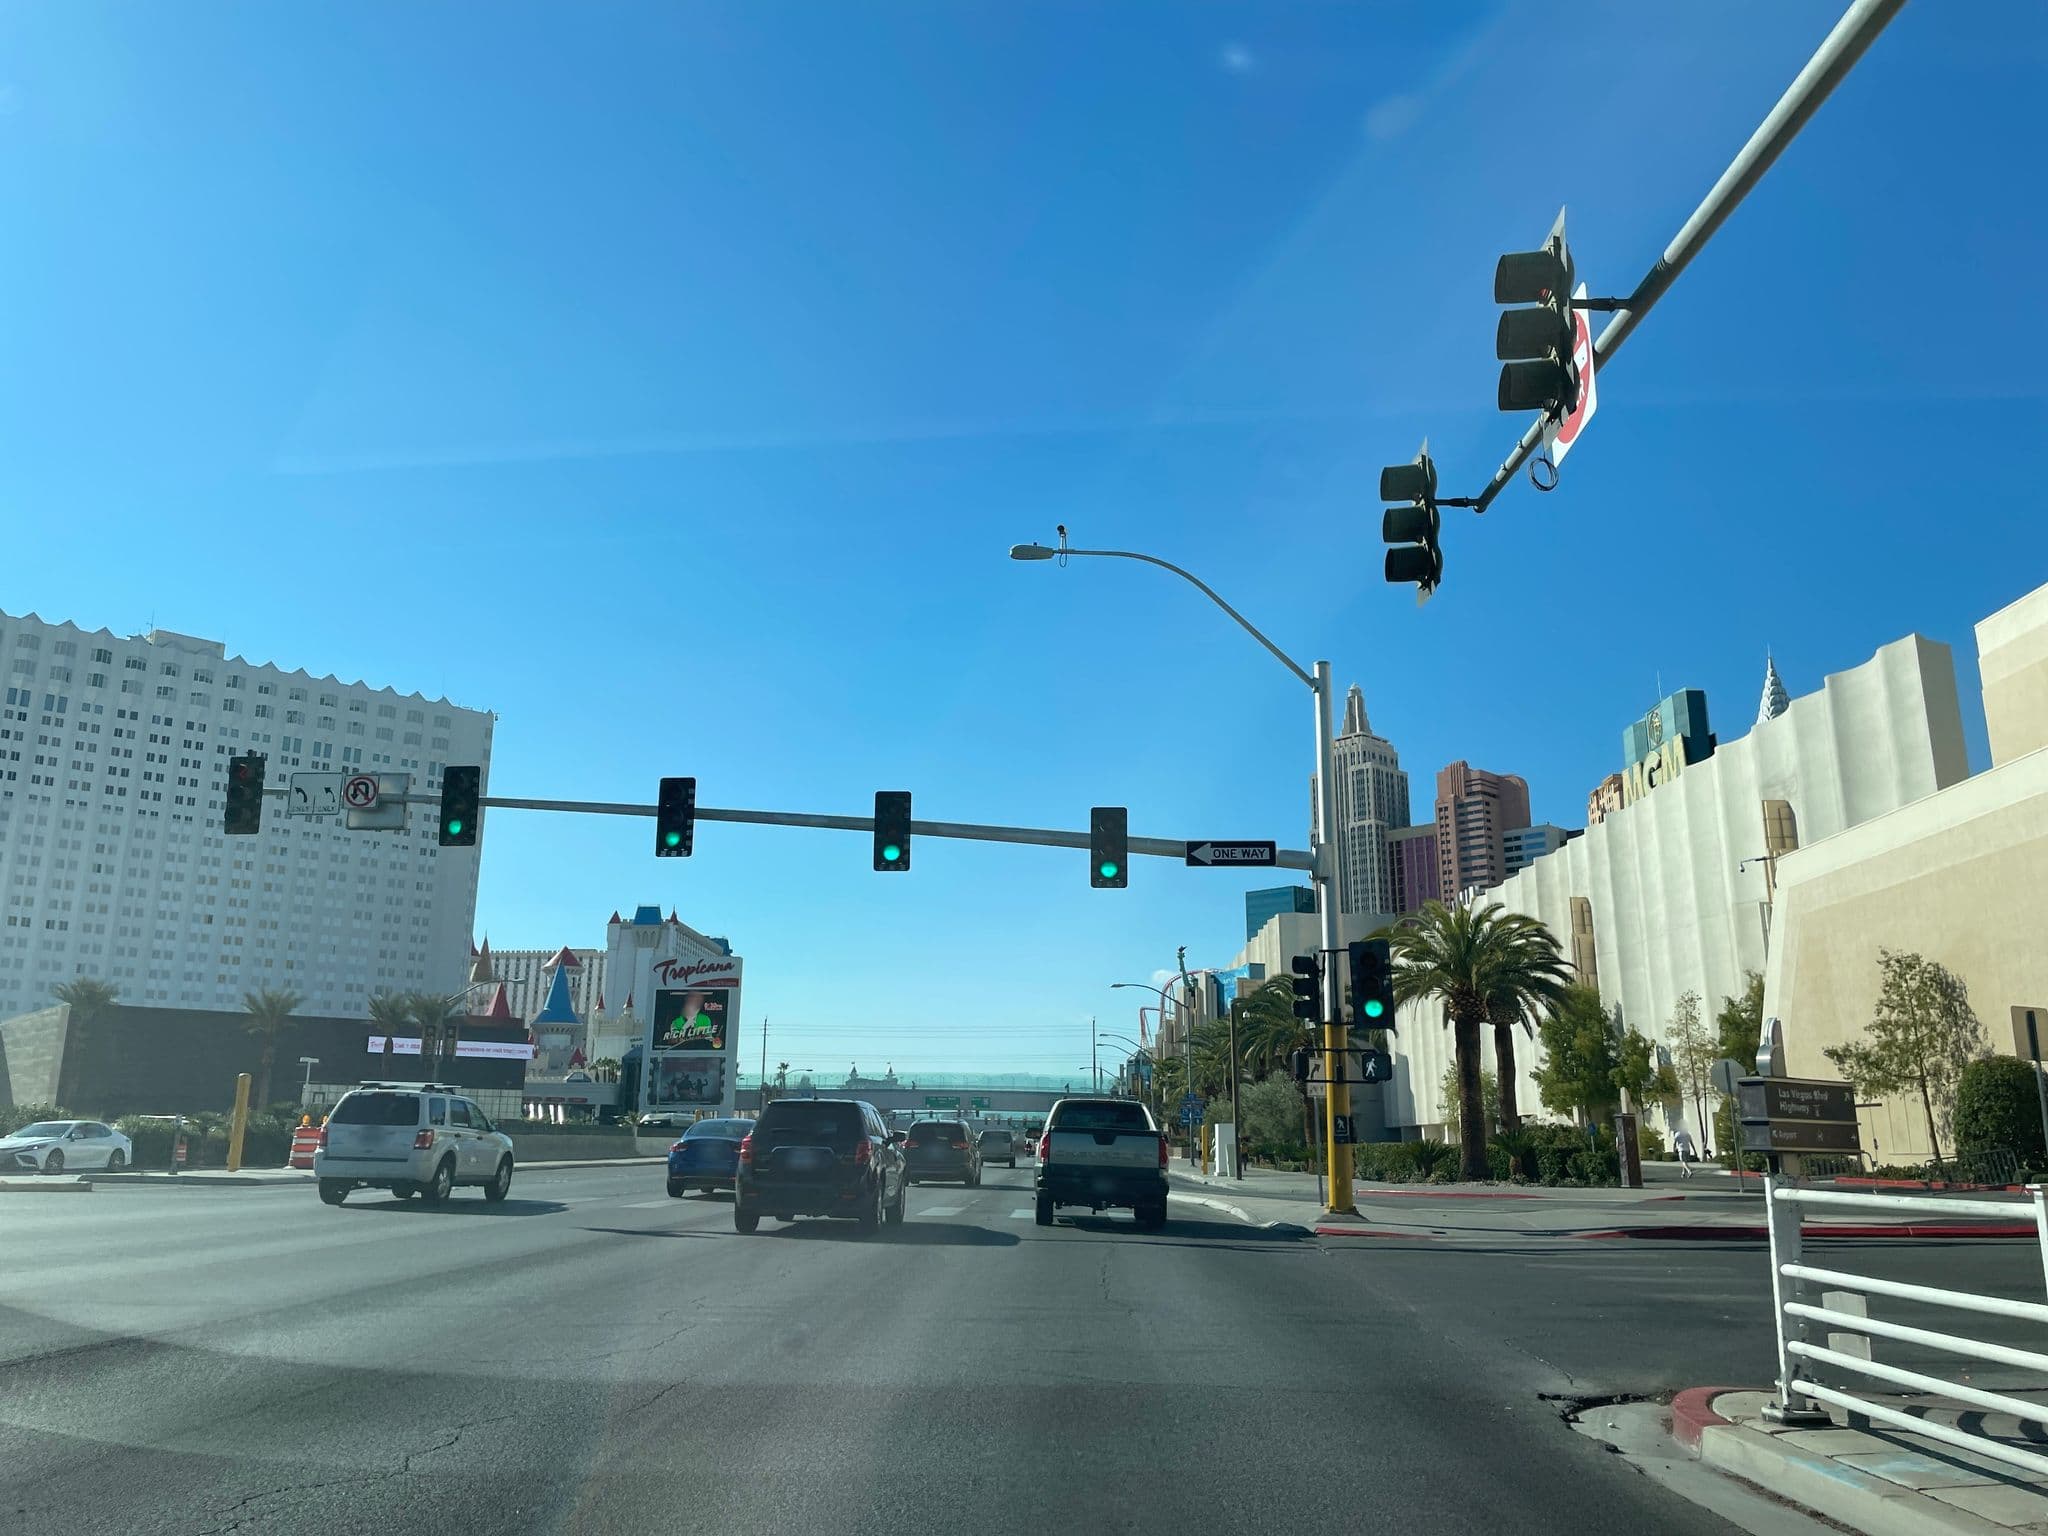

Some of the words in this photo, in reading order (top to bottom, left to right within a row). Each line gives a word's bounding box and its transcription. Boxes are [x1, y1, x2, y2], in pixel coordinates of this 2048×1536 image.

[1622, 733, 1684, 808] MGM
[1213, 848, 1237, 859] ONE
[1241, 848, 1266, 859] WAY
[653, 959, 735, 987] Tropicana
[663, 1029, 687, 1041] RICH
[688, 1024, 719, 1037] LITTLE
[1778, 1088, 1790, 1098] Las
[1790, 1089, 1813, 1101] Vegas
[1813, 1089, 1828, 1100] Blvd
[1779, 1101, 1810, 1114] Highway
